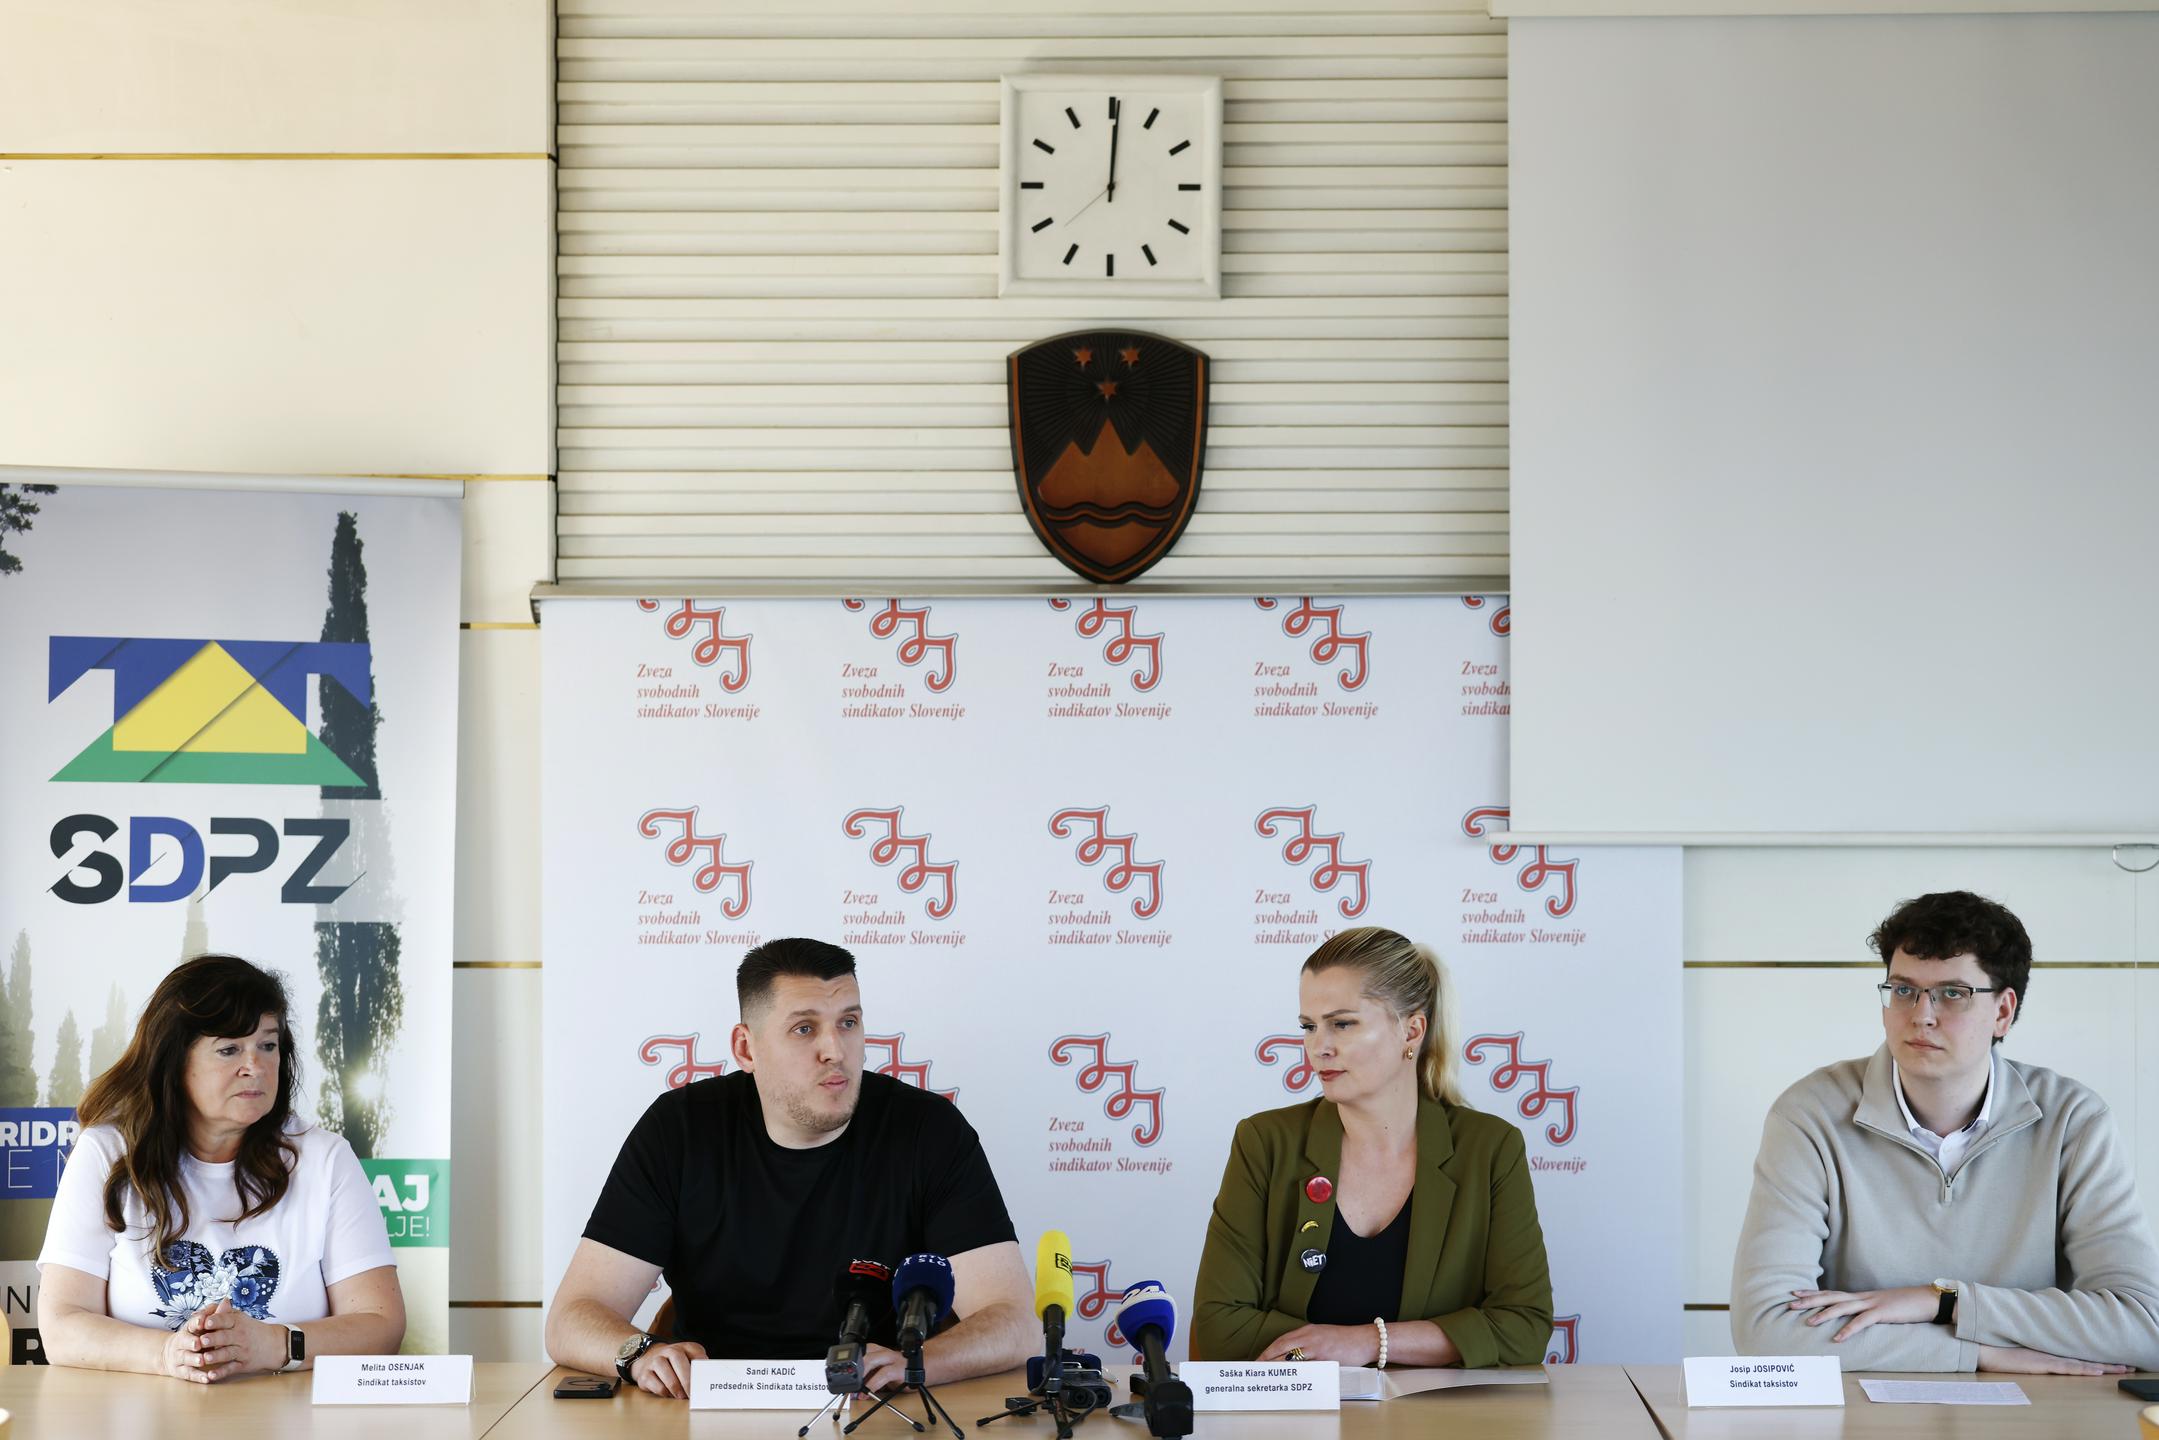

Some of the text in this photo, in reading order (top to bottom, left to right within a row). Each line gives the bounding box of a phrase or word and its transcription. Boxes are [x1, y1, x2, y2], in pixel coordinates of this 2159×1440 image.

[636, 663, 673, 679] Zveza
[841, 663, 878, 679] Zveza
[1047, 662, 1084, 678] Zveza
[1253, 661, 1291, 678] Zveza
[1461, 661, 1498, 676] Zveza
[637, 683, 700, 699] svobodnih
[841, 683, 905, 699] svobodnih
[1047, 682, 1111, 698] svobodnih
[1254, 681, 1318, 697] svobodnih
[1461, 681, 1511, 696] svobodn
[637, 703, 761, 722] sindikatov Slovenije
[842, 703, 966, 721] sindikatov Slovenije
[1047, 702, 1172, 721] sindikatov Slovenije
[1254, 701, 1379, 720] sindikatov Slovenije
[47, 813, 358, 904] SDPZ
[637, 890, 674, 906] Zveza
[842, 890, 879, 906] Zveza
[1048, 889, 1084, 906] Zveza
[1254, 889, 1291, 905] Zveza
[1461, 888, 1498, 904] Zveza
[638, 910, 701, 925] svobodnih
[842, 910, 906, 925] svobodnih
[1048, 910, 1112, 925] svobodnih
[1254, 909, 1319, 925] svobodnih
[1462, 908, 1526, 924] svobodnih
[637, 930, 761, 947] sindikatov Slovenije
[842, 930, 967, 949] sindikatov Slovenije
[1047, 929, 1173, 948] sindikatov Slovenije
[1254, 929, 1317, 945] sindikatov
[1461, 928, 1587, 947] sindikatov Slovenije
[1048, 1117, 1085, 1133] Zveza
[0, 1120, 80, 1147] RIDR
[1048, 1137, 1112, 1153] svobodnih
[1048, 1157, 1173, 1176] sindikatov Slovenije
[1530, 1156, 1587, 1174] Slovenije
[372, 1174, 430, 1212] AJ
[384, 1216, 430, 1237] LJE!
[361, 1362, 425, 1372] Melita OSENJAK
[745, 1366, 796, 1376] Sandi KADIĆ
[1219, 1368, 1298, 1378] Saška Kiara KUMER
[1729, 1362, 1795, 1375] Josip JOSIPOVIĆ
[357, 1377, 427, 1387] Sindikat taksistov
[709, 1381, 755, 1391] predsednik
[756, 1382, 794, 1391] Sindikata
[1204, 1382, 1313, 1395] generalna sekretarka SDPZ
[1729, 1379, 1799, 1389] Sindikat taksistov
